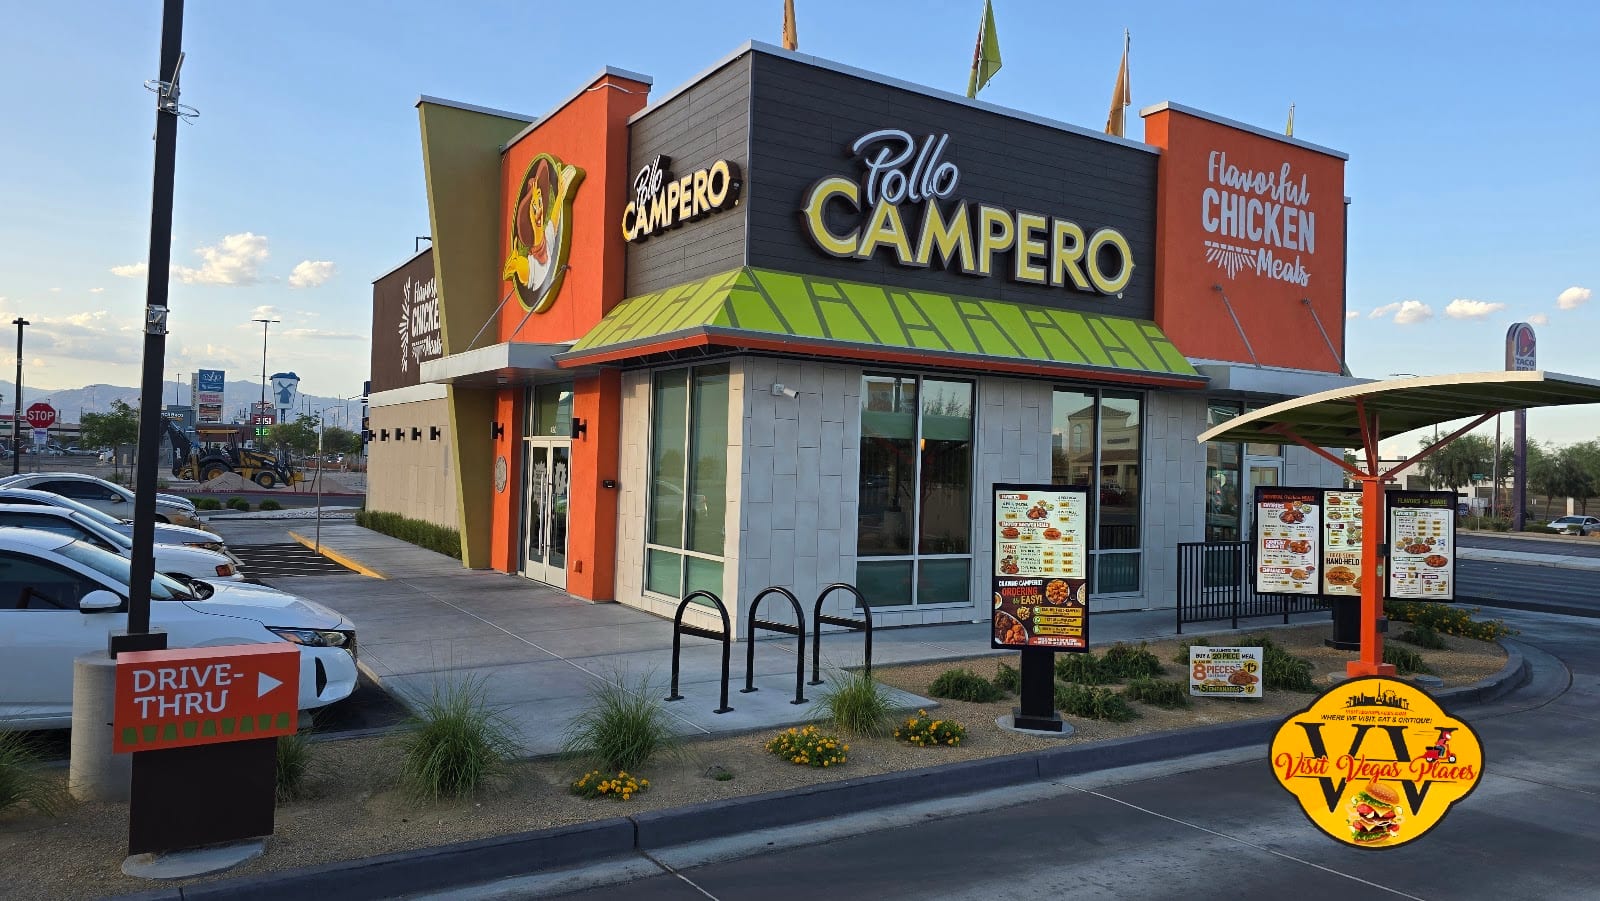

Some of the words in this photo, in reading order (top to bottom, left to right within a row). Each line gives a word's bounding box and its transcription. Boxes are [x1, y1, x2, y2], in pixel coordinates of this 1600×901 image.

[634, 153, 663, 210] Pollo
[852, 129, 960, 205] Pollo
[1208, 150, 1310, 206] Flavorful
[622, 159, 731, 242] CAMPERO
[1202, 187, 1315, 255] CHICKEN
[802, 176, 1136, 297] CAMPERO
[1256, 247, 1312, 287] Meals
[412, 298, 441, 338] CHICKE
[1516, 358, 1535, 366] TACO
[27, 410, 54, 421] STOP
[1326, 557, 1360, 566] HAND-HELD
[1002, 587, 1038, 596] ORDERING
[1021, 594, 1043, 605] EASY!
[1212, 652, 1222, 660] 20
[132, 663, 244, 693] DRIVE-
[1193, 663, 1207, 681] 8
[1206, 665, 1236, 674] PIECES
[1201, 684, 1208, 693] 5
[133, 690, 229, 720] THRU
